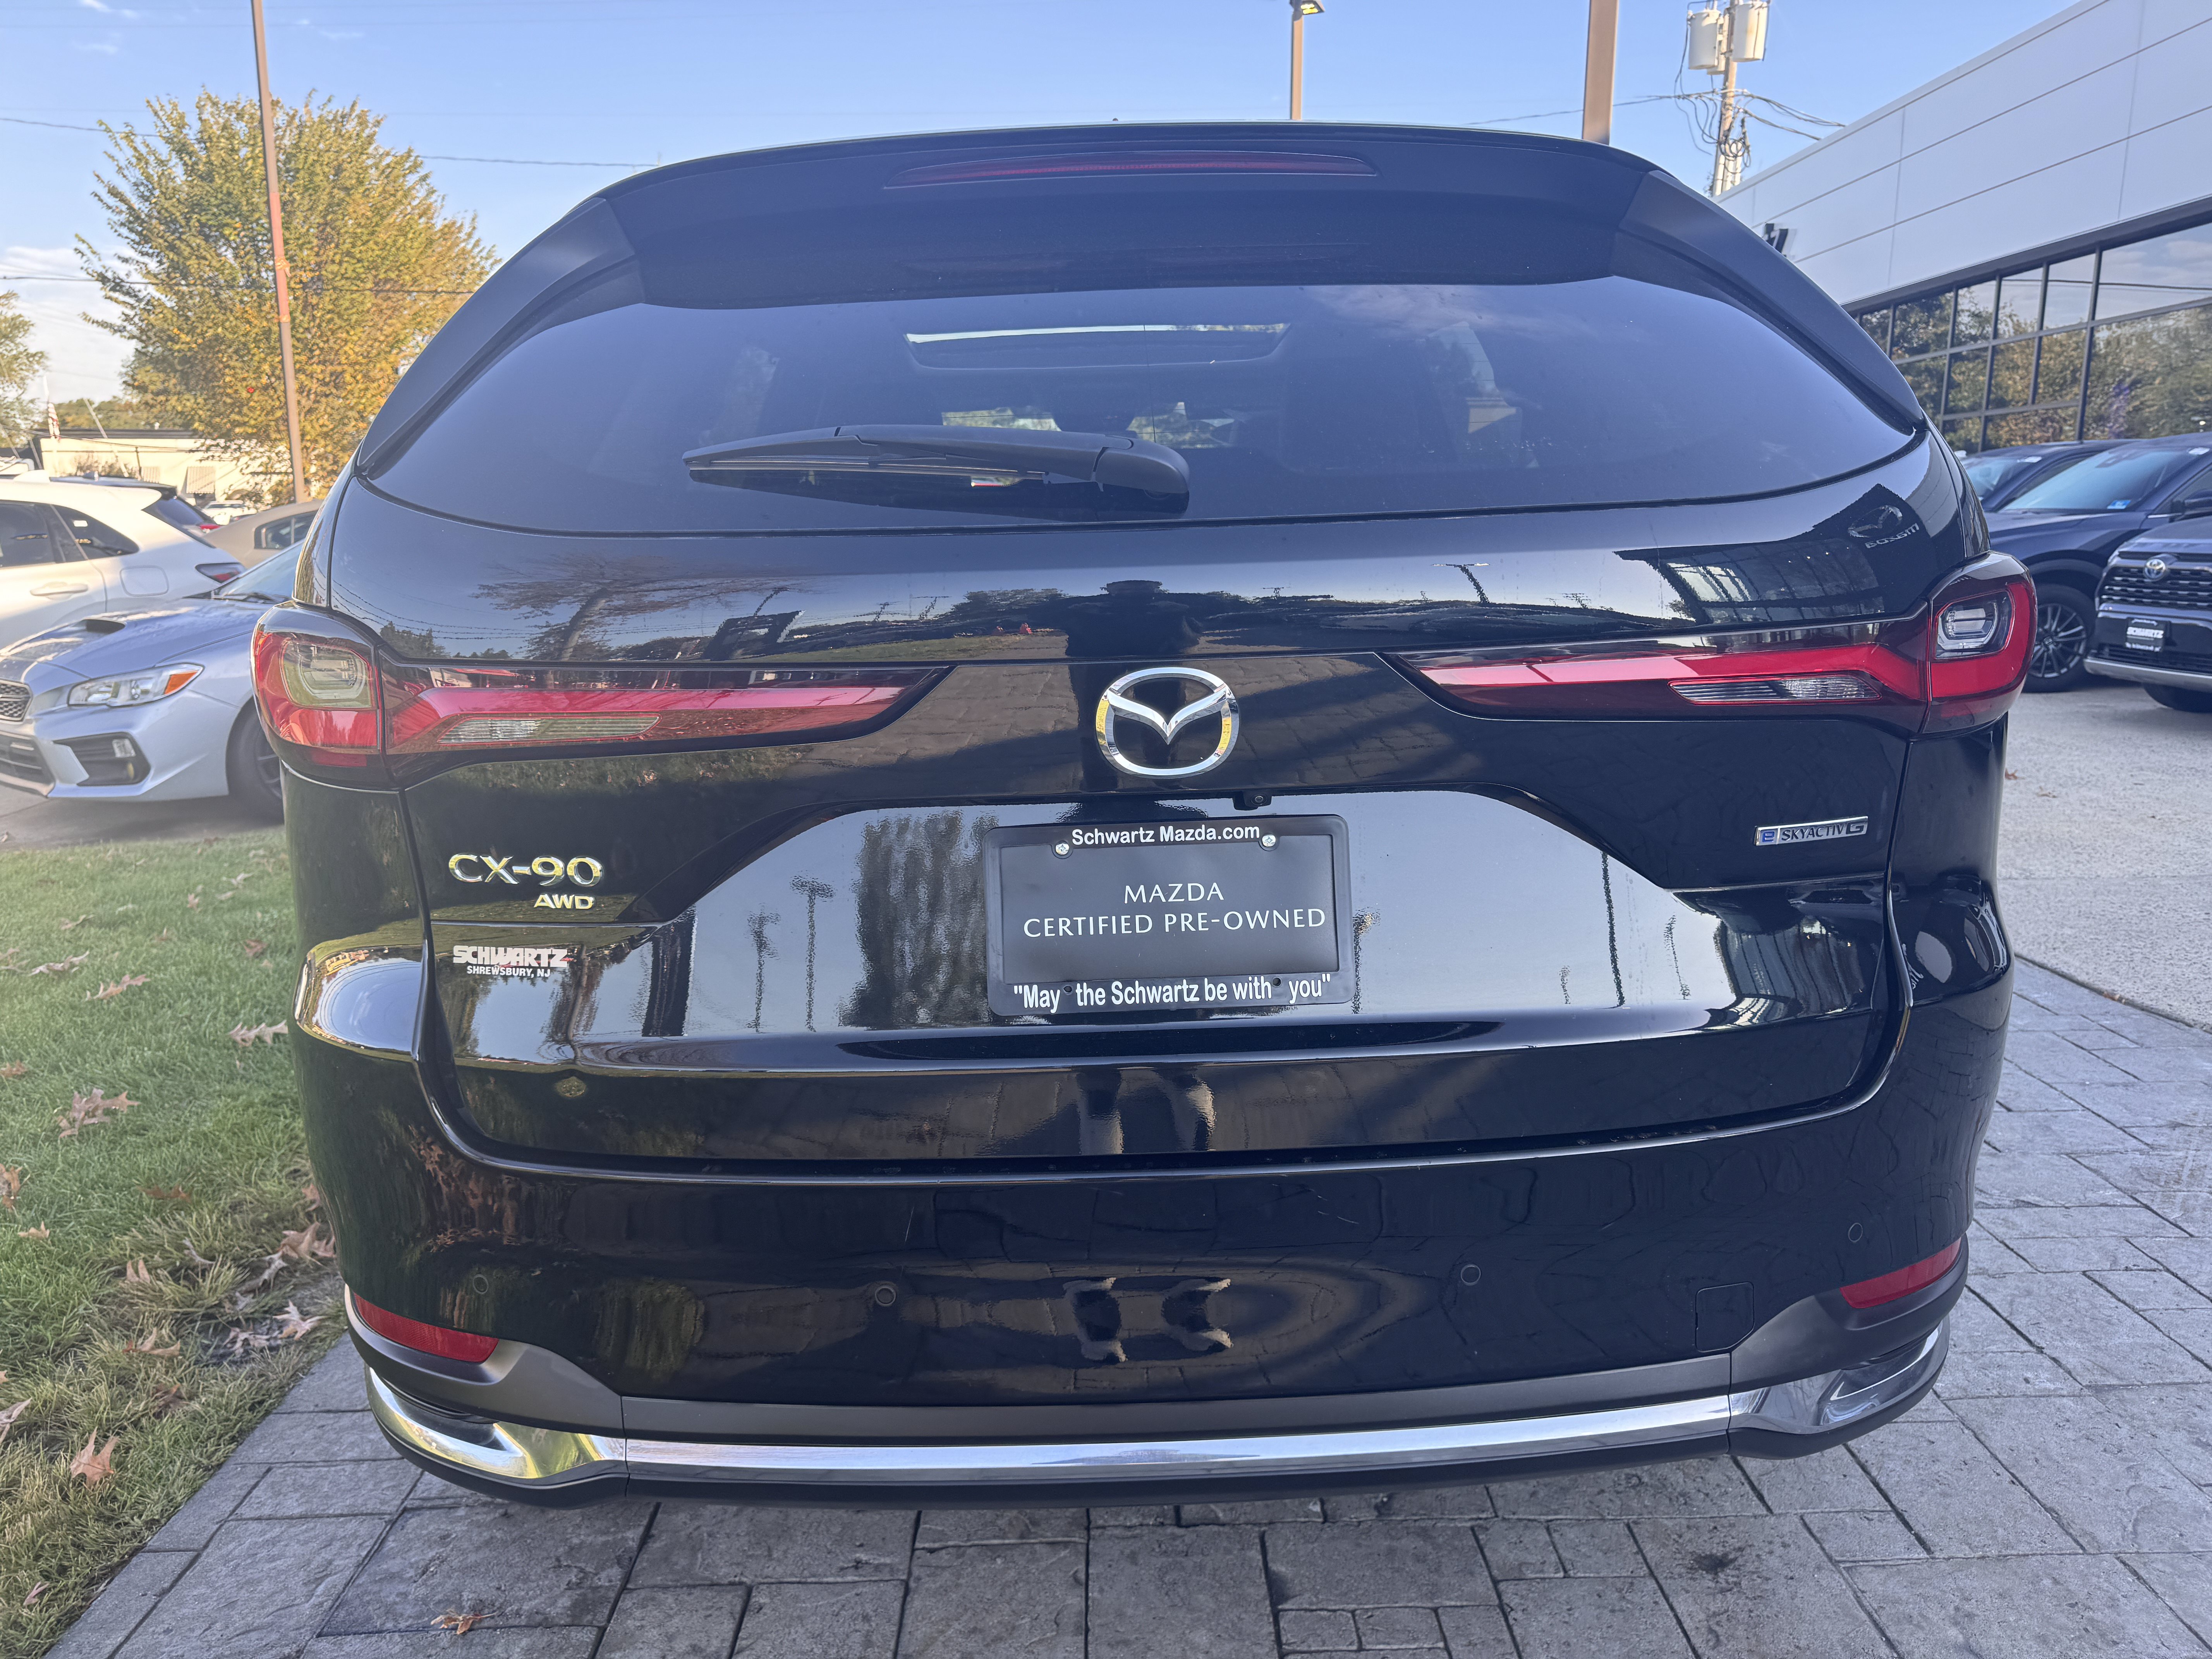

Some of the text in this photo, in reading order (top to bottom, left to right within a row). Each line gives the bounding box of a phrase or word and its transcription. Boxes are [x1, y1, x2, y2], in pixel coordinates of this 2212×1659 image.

[1072, 824, 1260, 845] Schwartz Mazda.com
[448, 853, 603, 888] CX-90
[533, 893, 595, 910] AWD
[1124, 882, 1224, 905] MAZDA
[1024, 908, 1326, 938] CERTIFIED PRE-OWNED
[453, 945, 568, 968] SCHWARTZ
[466, 965, 551, 978] SHREWSBURY, NJ
[1013, 973, 1331, 1014] "May the Schwartz be with you"
